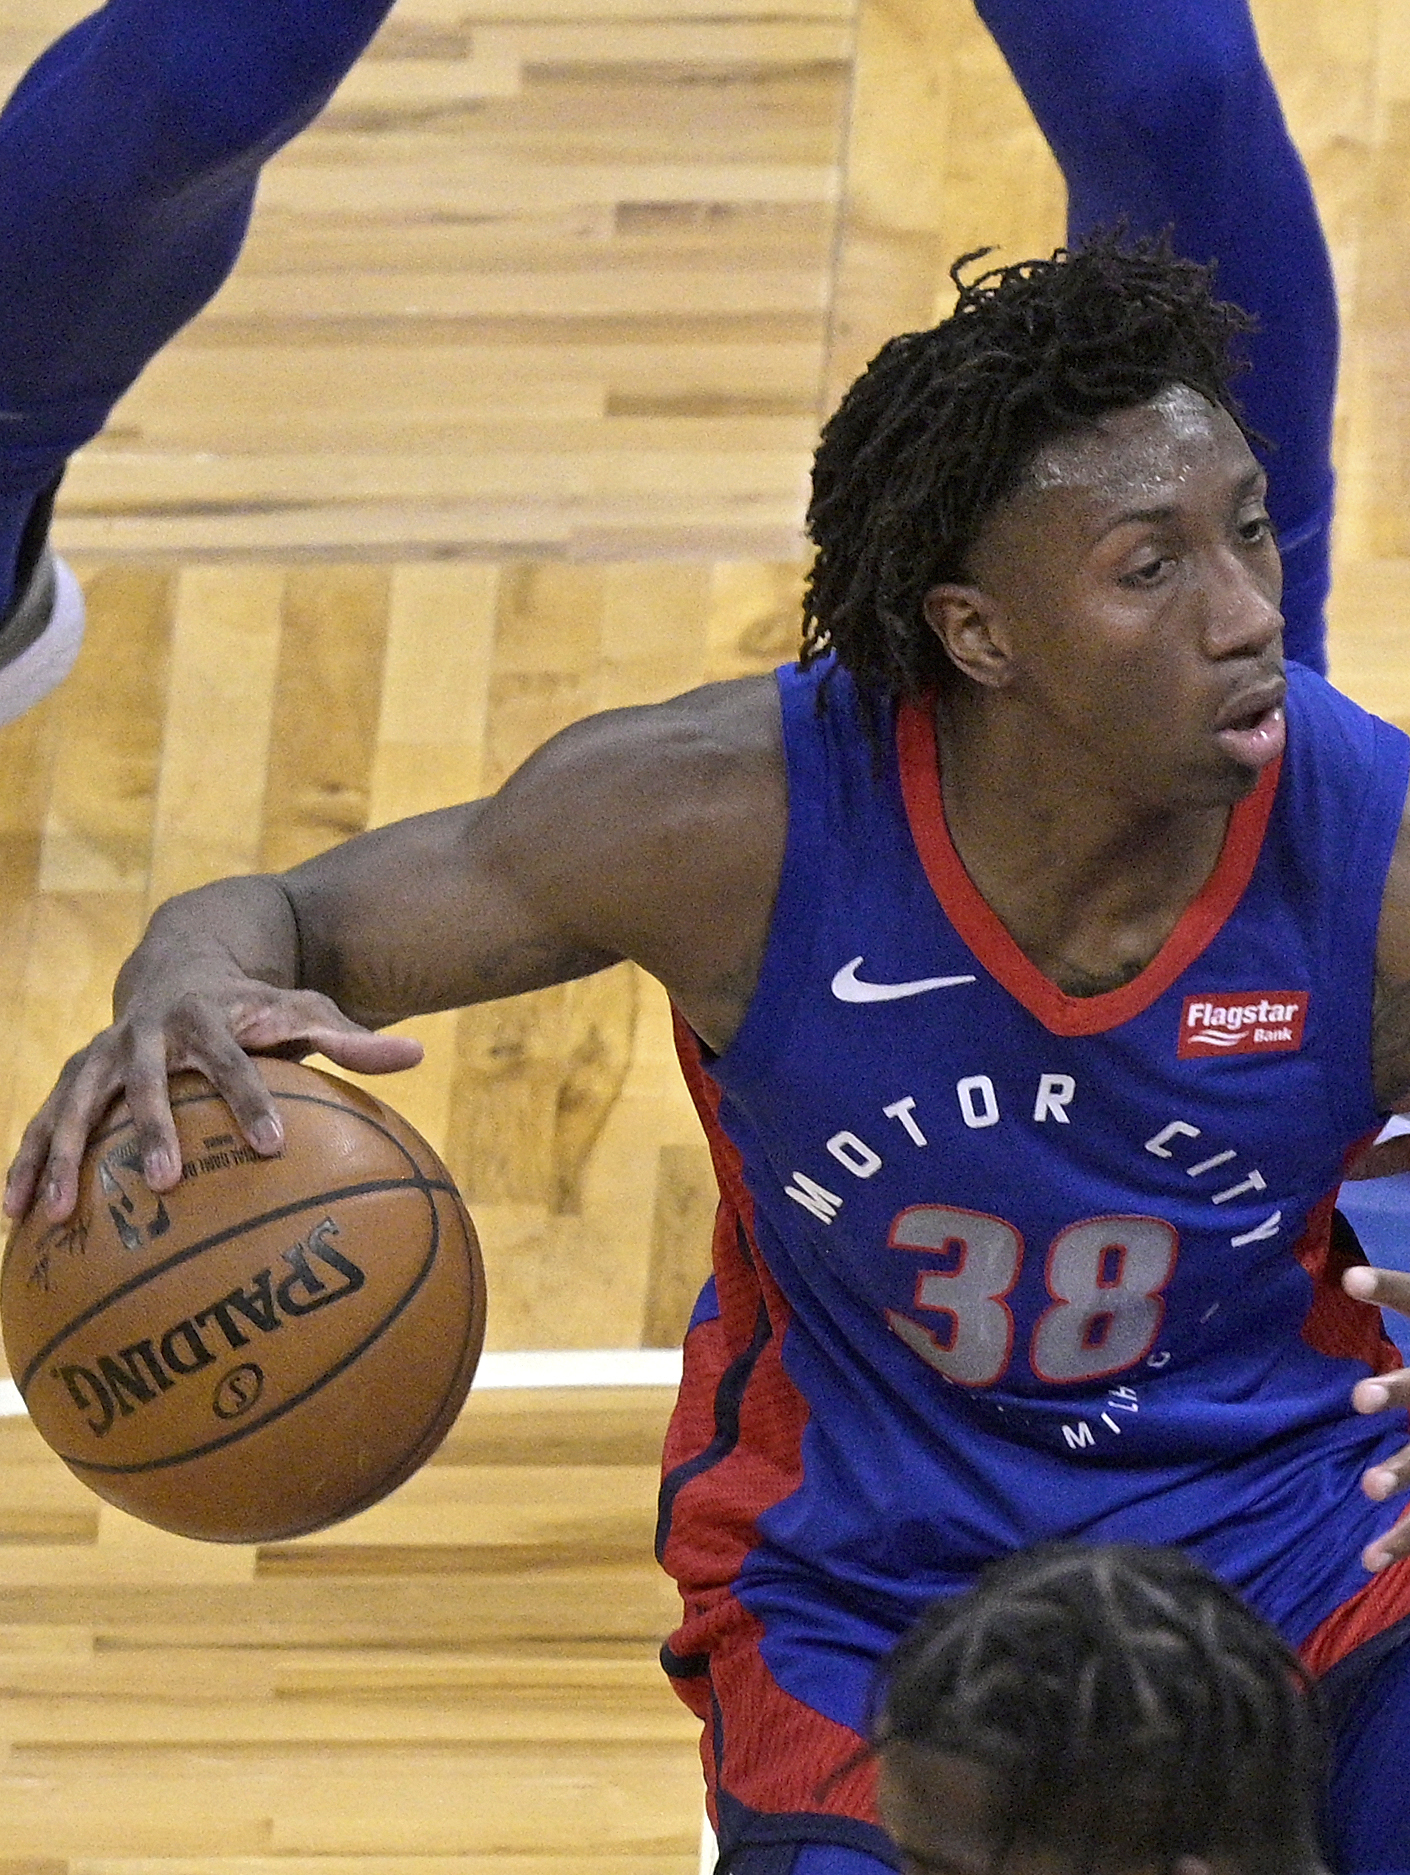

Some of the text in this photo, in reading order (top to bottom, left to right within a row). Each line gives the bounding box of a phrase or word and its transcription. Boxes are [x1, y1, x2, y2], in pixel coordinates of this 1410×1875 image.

[1187, 999, 1300, 1031] Flagstar
[1253, 1026, 1293, 1043] Bank
[784, 1073, 1282, 1249] MOTOR CITY
[51, 1216, 366, 1439] SPALDING
[886, 1203, 1180, 1388] 38
